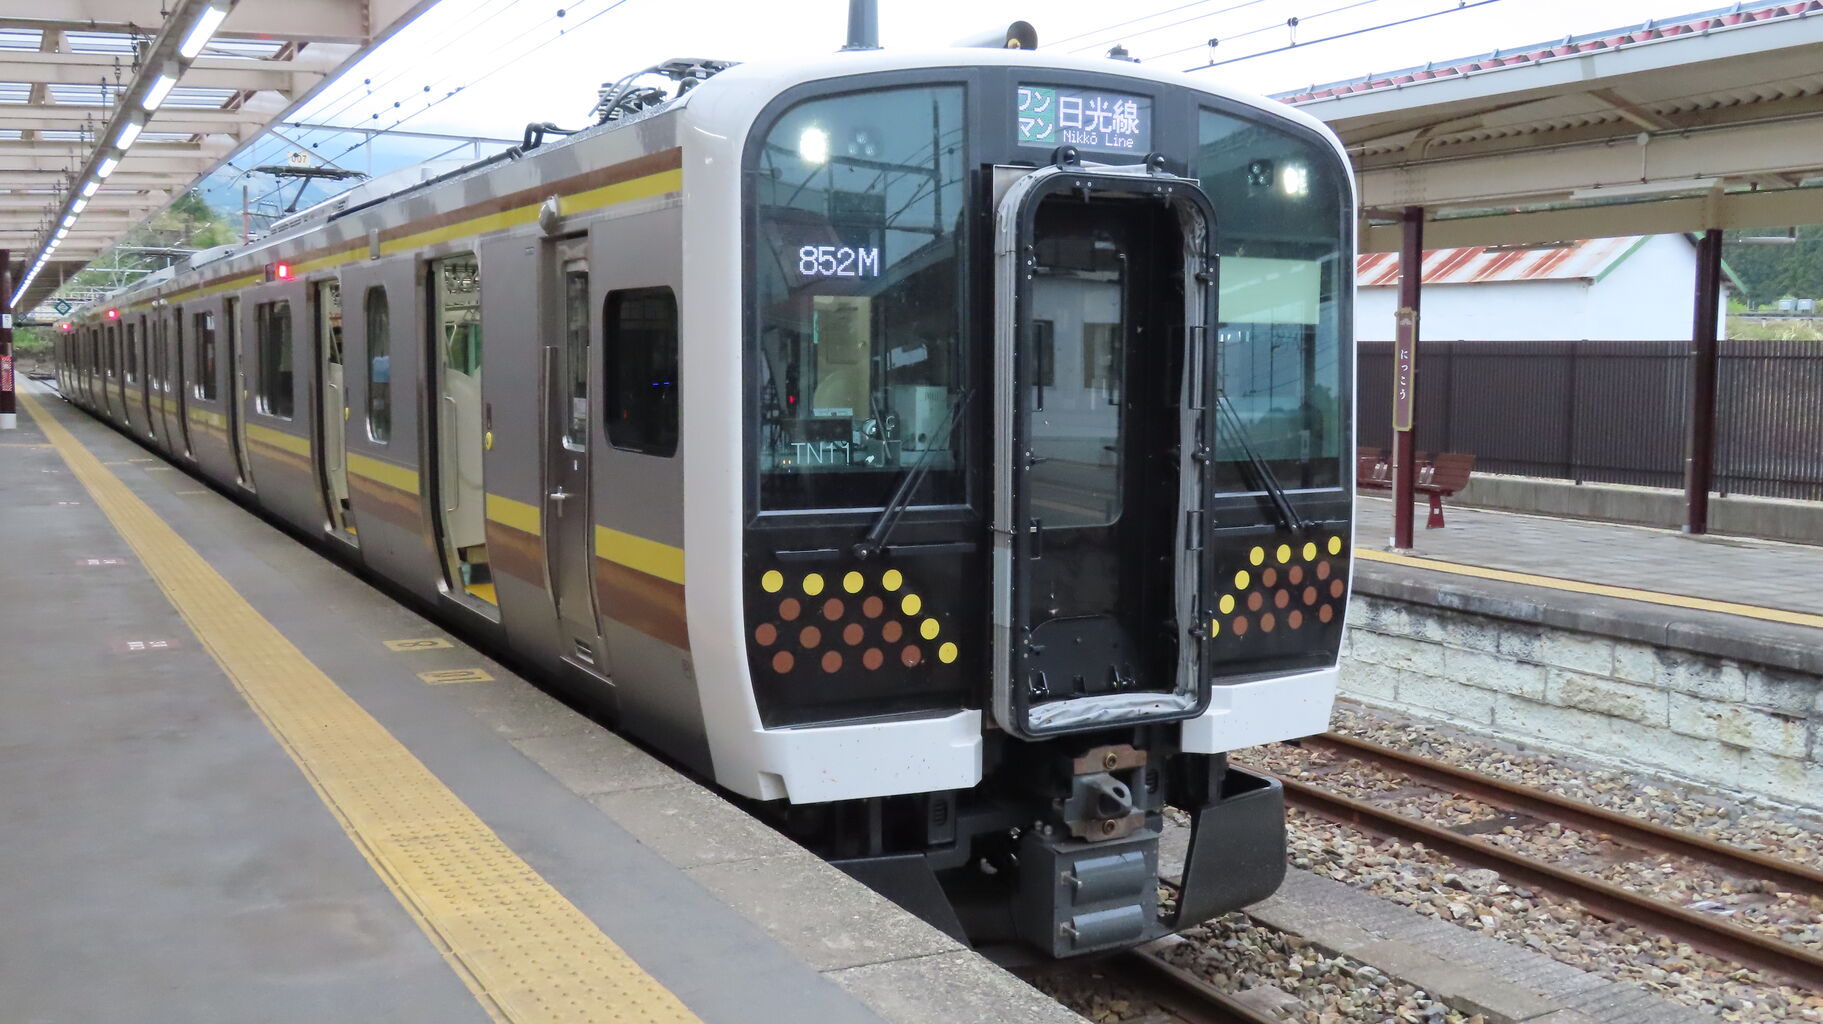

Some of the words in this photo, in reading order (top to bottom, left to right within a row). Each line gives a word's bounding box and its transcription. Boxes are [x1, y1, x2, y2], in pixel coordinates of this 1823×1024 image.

[1018, 89, 1051, 113] ワン
[1018, 117, 1053, 139] マン
[1059, 96, 1140, 135] 日光線
[1063, 130, 1098, 145] Nikkō
[1105, 133, 1134, 147] Line
[799, 246, 879, 277] 852M
[1399, 349, 1409, 400] にっこう
